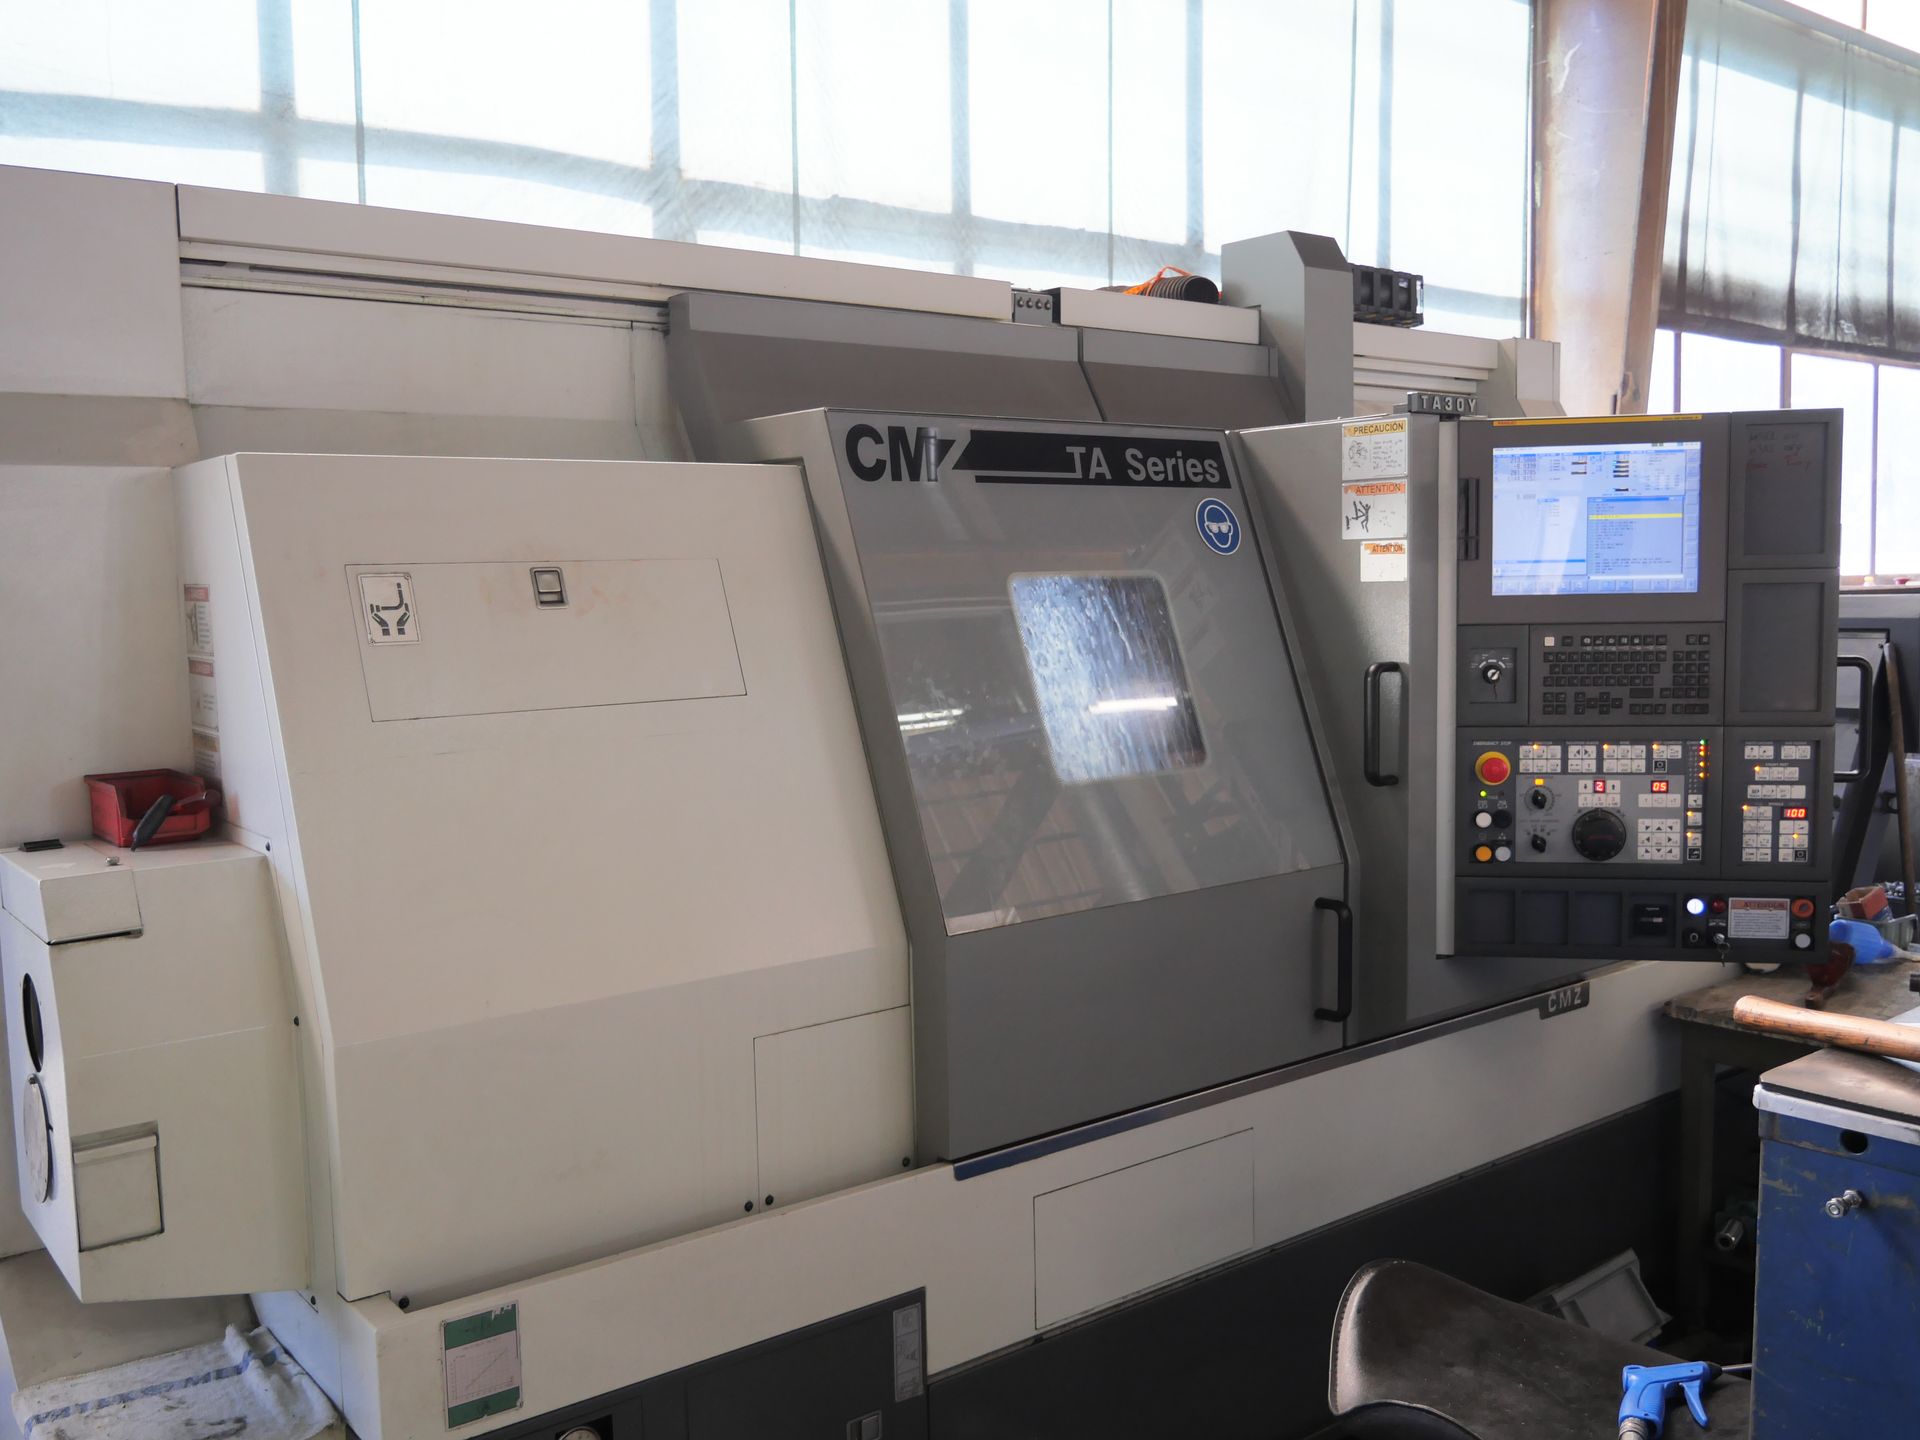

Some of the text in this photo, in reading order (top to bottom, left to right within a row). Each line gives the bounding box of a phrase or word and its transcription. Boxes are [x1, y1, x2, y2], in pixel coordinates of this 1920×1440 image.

[1421, 395, 1477, 412] TA30Y
[1065, 446, 1220, 484] TA Series
[1355, 483, 1401, 494] ATTENTION
[1372, 544, 1403, 553] ATTENTION
[1595, 781, 1604, 792] 2
[1652, 781, 1667, 791] 05
[1785, 808, 1806, 818] 100
[1548, 987, 1581, 1012] CMZ
